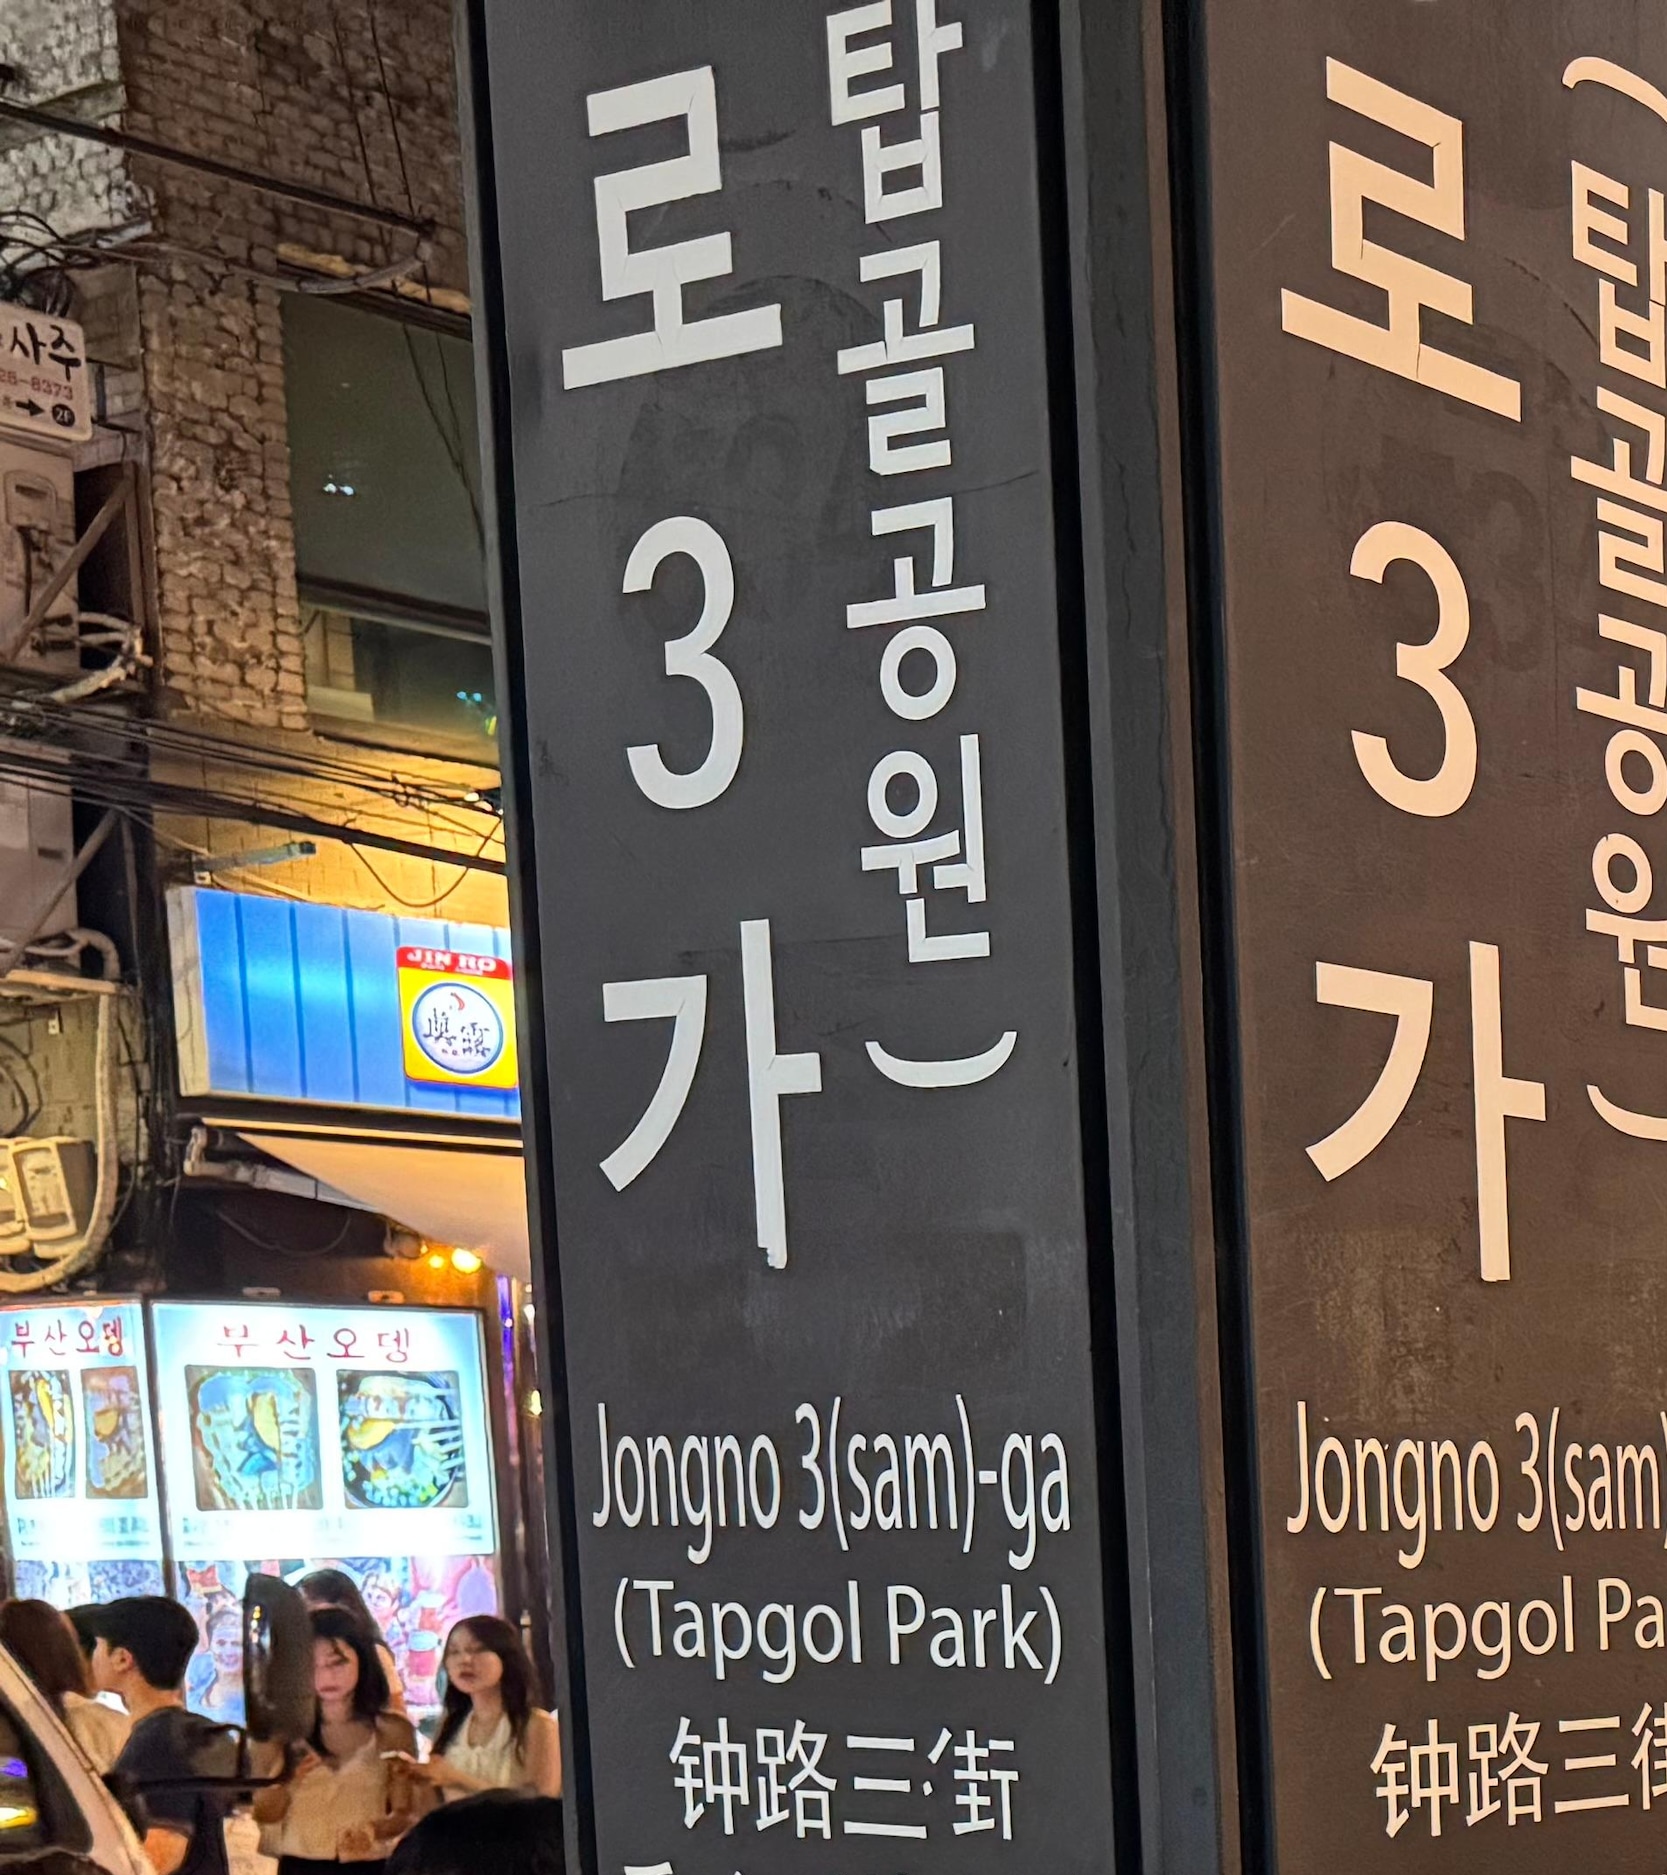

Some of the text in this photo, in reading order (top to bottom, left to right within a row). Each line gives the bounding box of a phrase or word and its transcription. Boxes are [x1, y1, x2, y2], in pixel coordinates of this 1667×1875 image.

[593, 1393, 1071, 1569] Jongno 3(sam)-ga
[1286, 1400, 1502, 1570] Jongno
[613, 1577, 1064, 1685] (Tapgol Park)
[1309, 1585, 1575, 1682] (Tapgol
[668, 1716, 1019, 1842] 钟路三街
